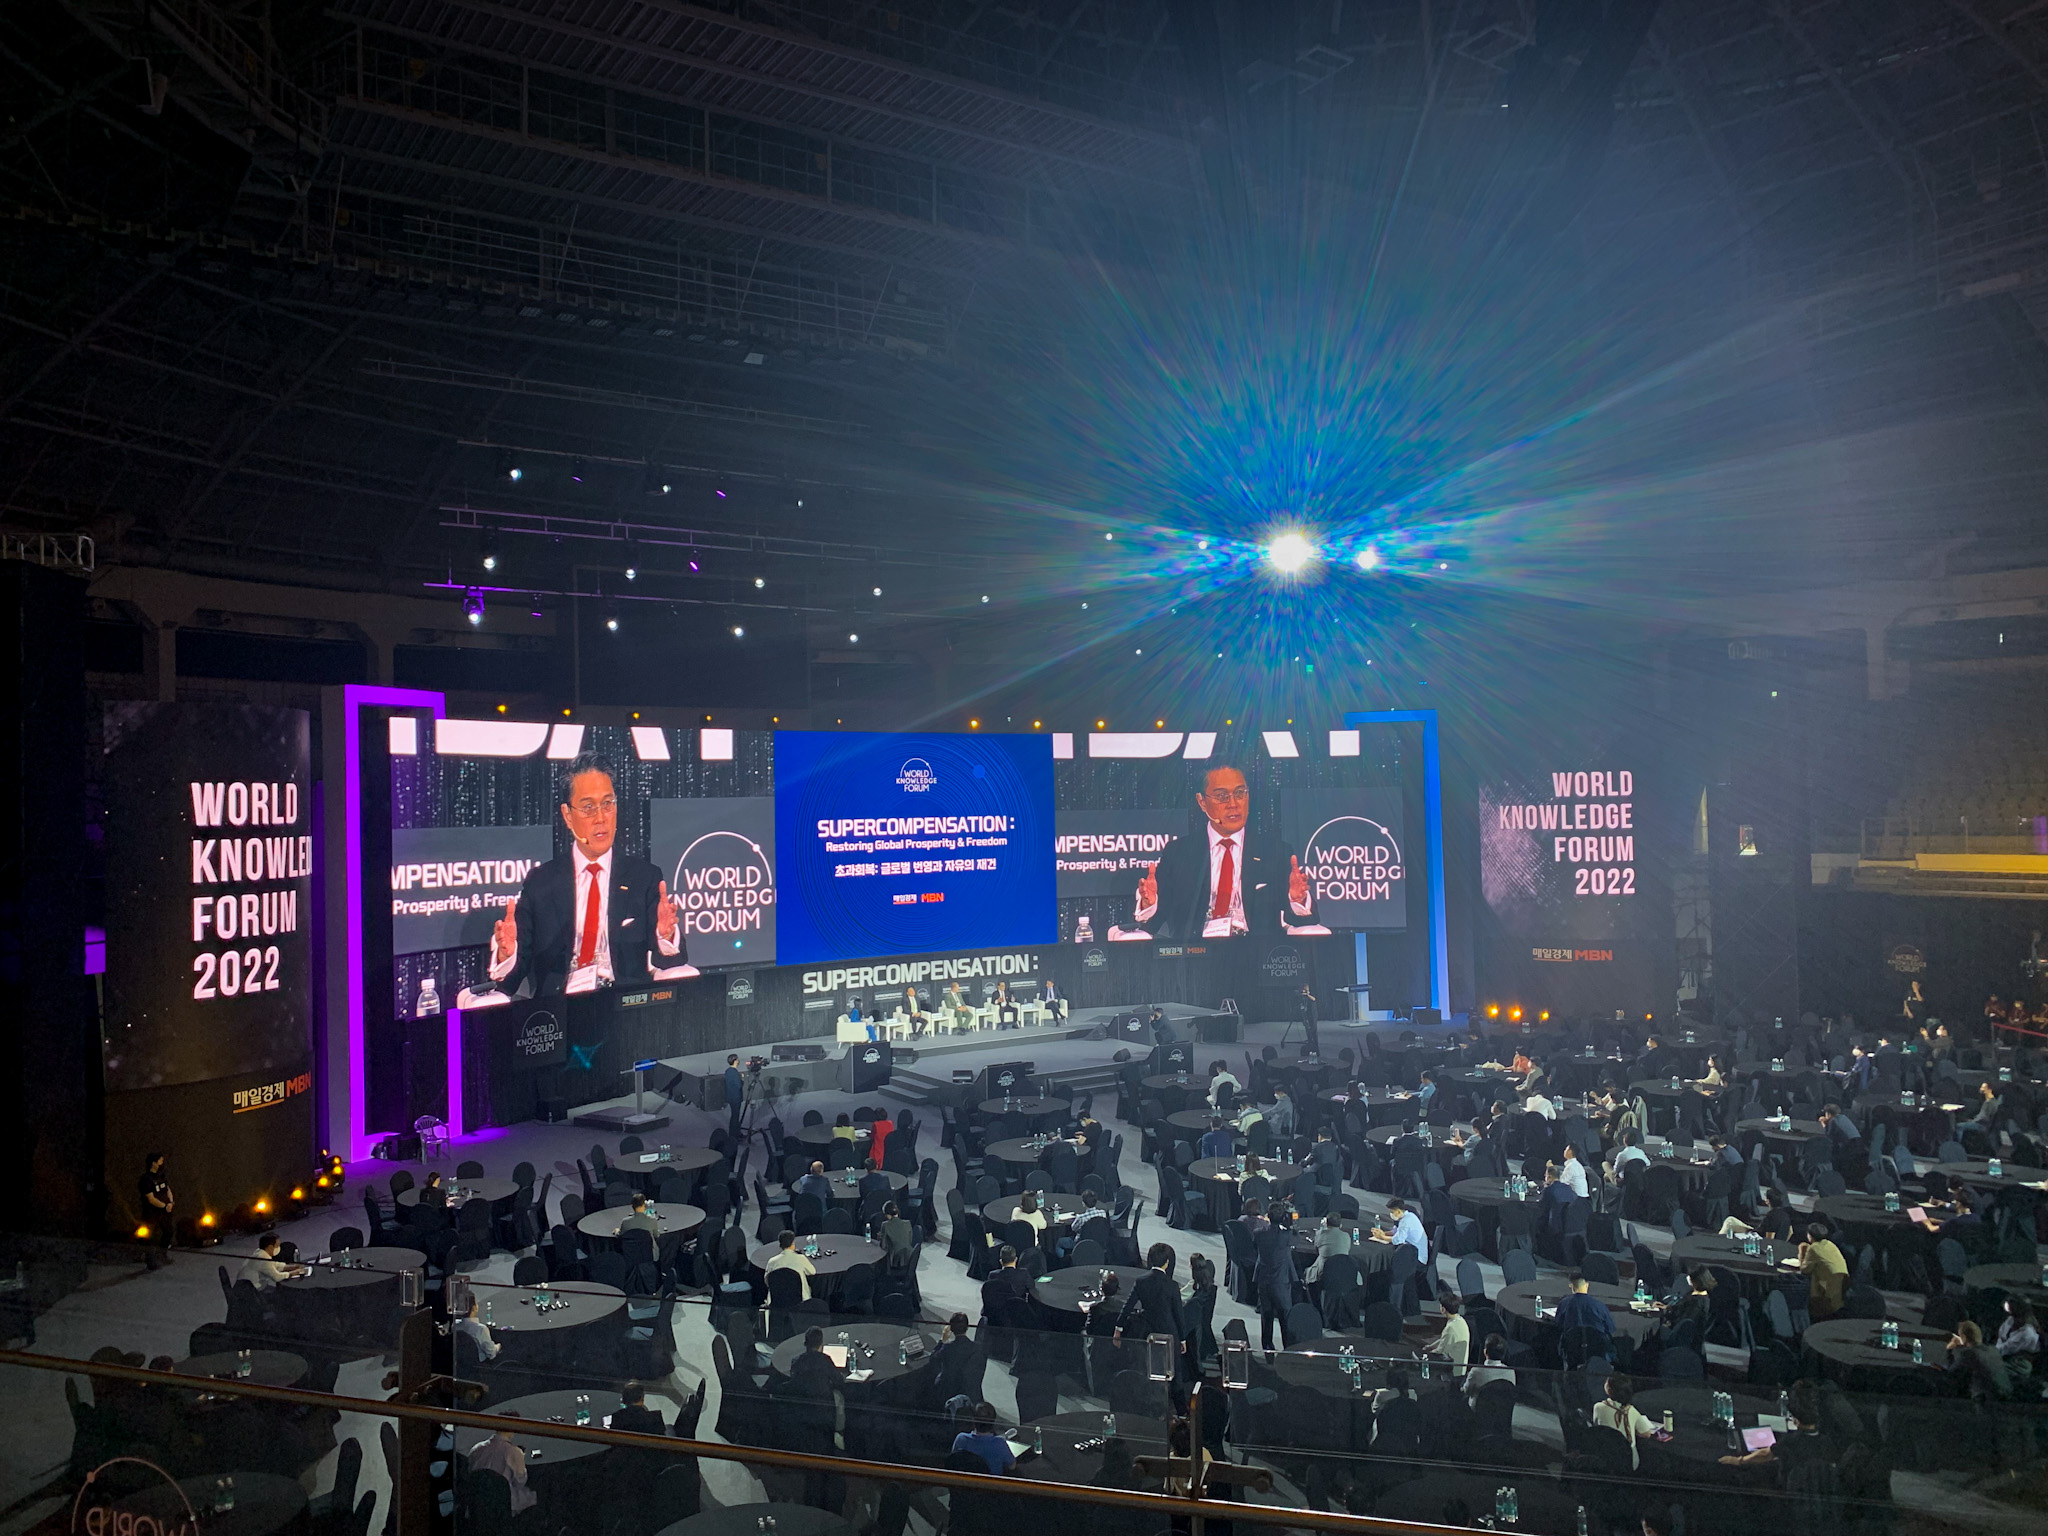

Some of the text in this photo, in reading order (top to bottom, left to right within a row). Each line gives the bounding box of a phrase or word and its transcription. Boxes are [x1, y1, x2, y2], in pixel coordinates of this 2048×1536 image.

[904, 770, 929, 778] WORLD
[904, 784, 929, 792] FORUM
[1552, 771, 1633, 798] WORLD
[190, 781, 298, 827] WORLD
[1500, 803, 1633, 830] KNOWLEDGE
[825, 836, 1008, 853] Restoring Global Prosperity & Freedom
[1554, 836, 1634, 862] FORUM
[1315, 845, 1390, 864] WORLD
[834, 858, 997, 877] 초과회복: 글로벌 번영과 자유의 재건
[1056, 858, 1116, 872] Prosperity
[1118, 858, 1127, 869] &
[1298, 865, 1406, 880] NOWLEDG
[684, 865, 762, 891] WORLD
[1575, 868, 1636, 895] 2022
[667, 888, 778, 910] NOWLEDG
[920, 892, 945, 903] MBN
[1316, 881, 1390, 901] FORUM
[392, 894, 470, 916] Prosperity
[471, 893, 482, 908] &
[193, 890, 297, 942] FORUM
[684, 907, 761, 935] FORUM
[1532, 948, 1613, 961] 매일경제 MBN
[193, 945, 280, 1000] 2022
[1270, 969, 1298, 977] FORUM
[651, 991, 672, 1001] MBN
[516, 1031, 564, 1047] KNOWLEDGE
[525, 1023, 555, 1037] WORLD
[525, 1041, 555, 1056] FORUM
[233, 1070, 312, 1108] 매일경제 MBN
